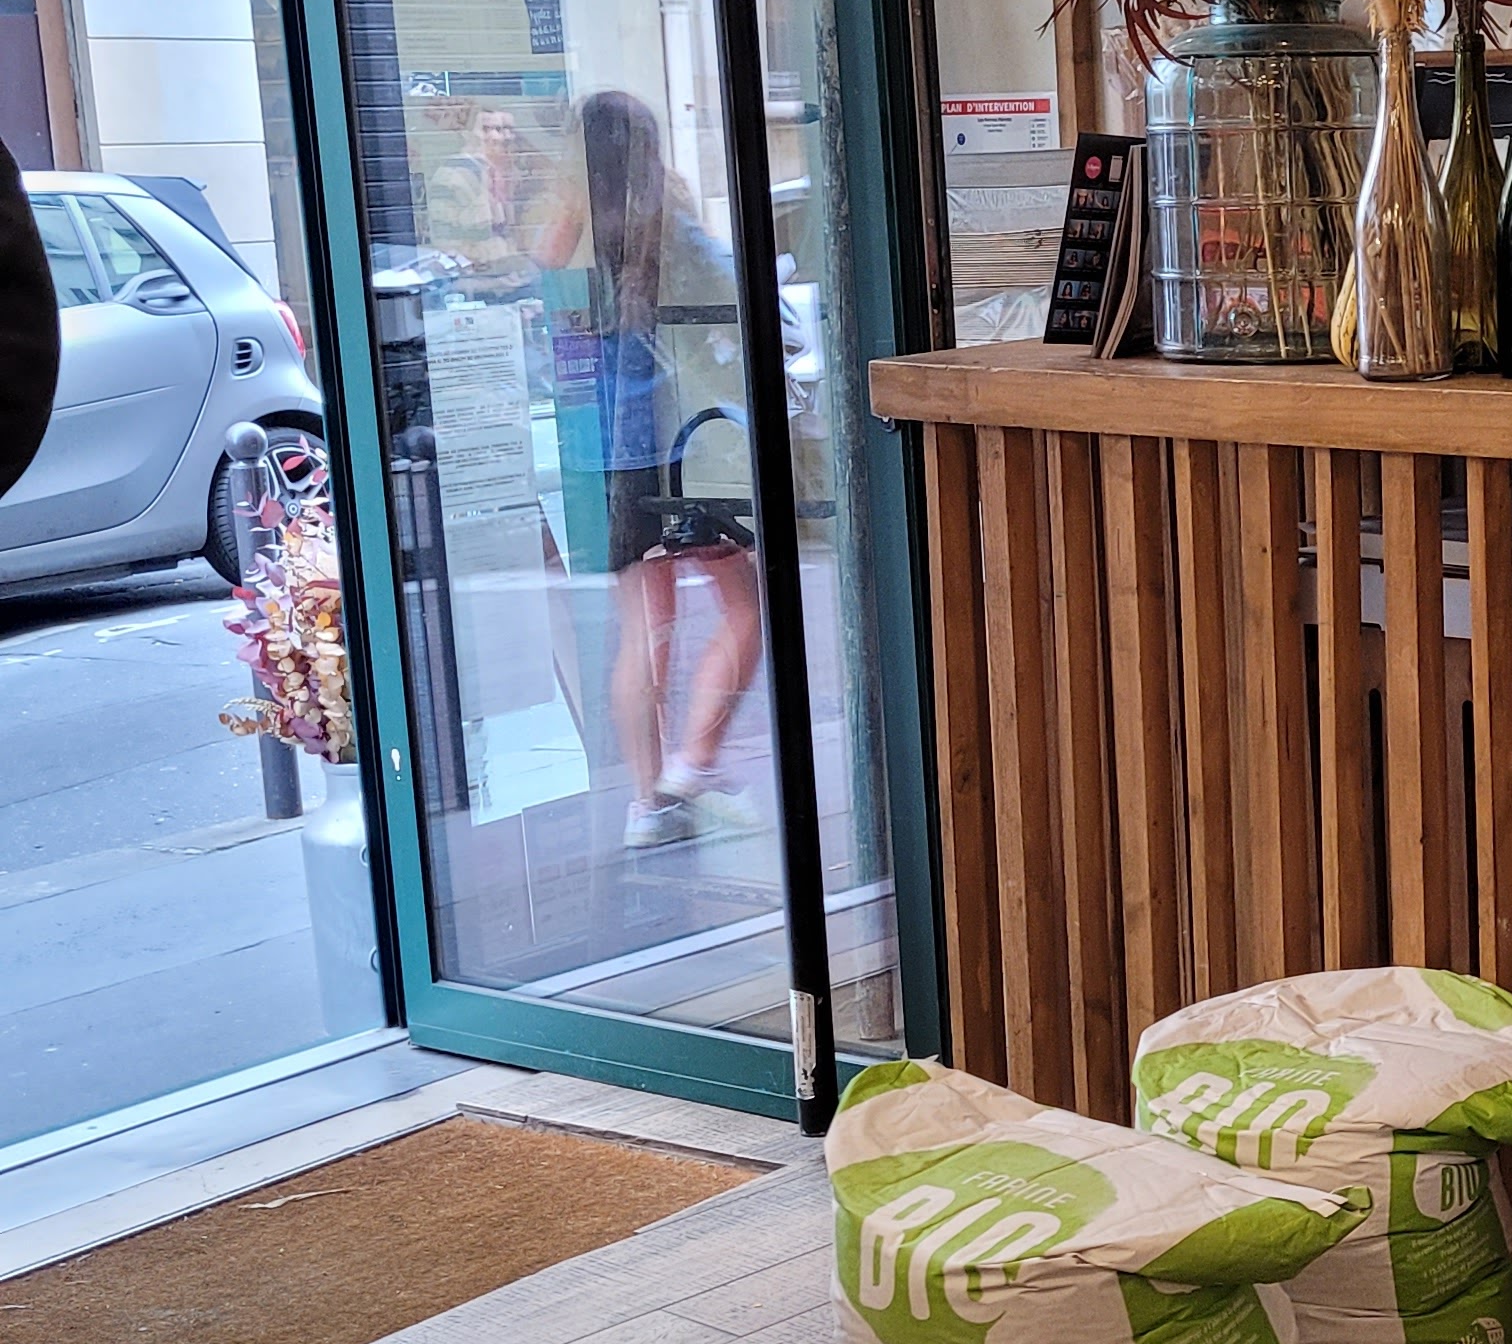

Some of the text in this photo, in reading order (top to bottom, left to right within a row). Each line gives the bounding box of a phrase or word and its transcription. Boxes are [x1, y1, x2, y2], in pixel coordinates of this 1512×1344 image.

[941, 101, 1035, 113] PLAN D'INTERVENTION
[961, 1170, 1077, 1209] FARINE
[859, 1183, 1062, 1324] BIO
